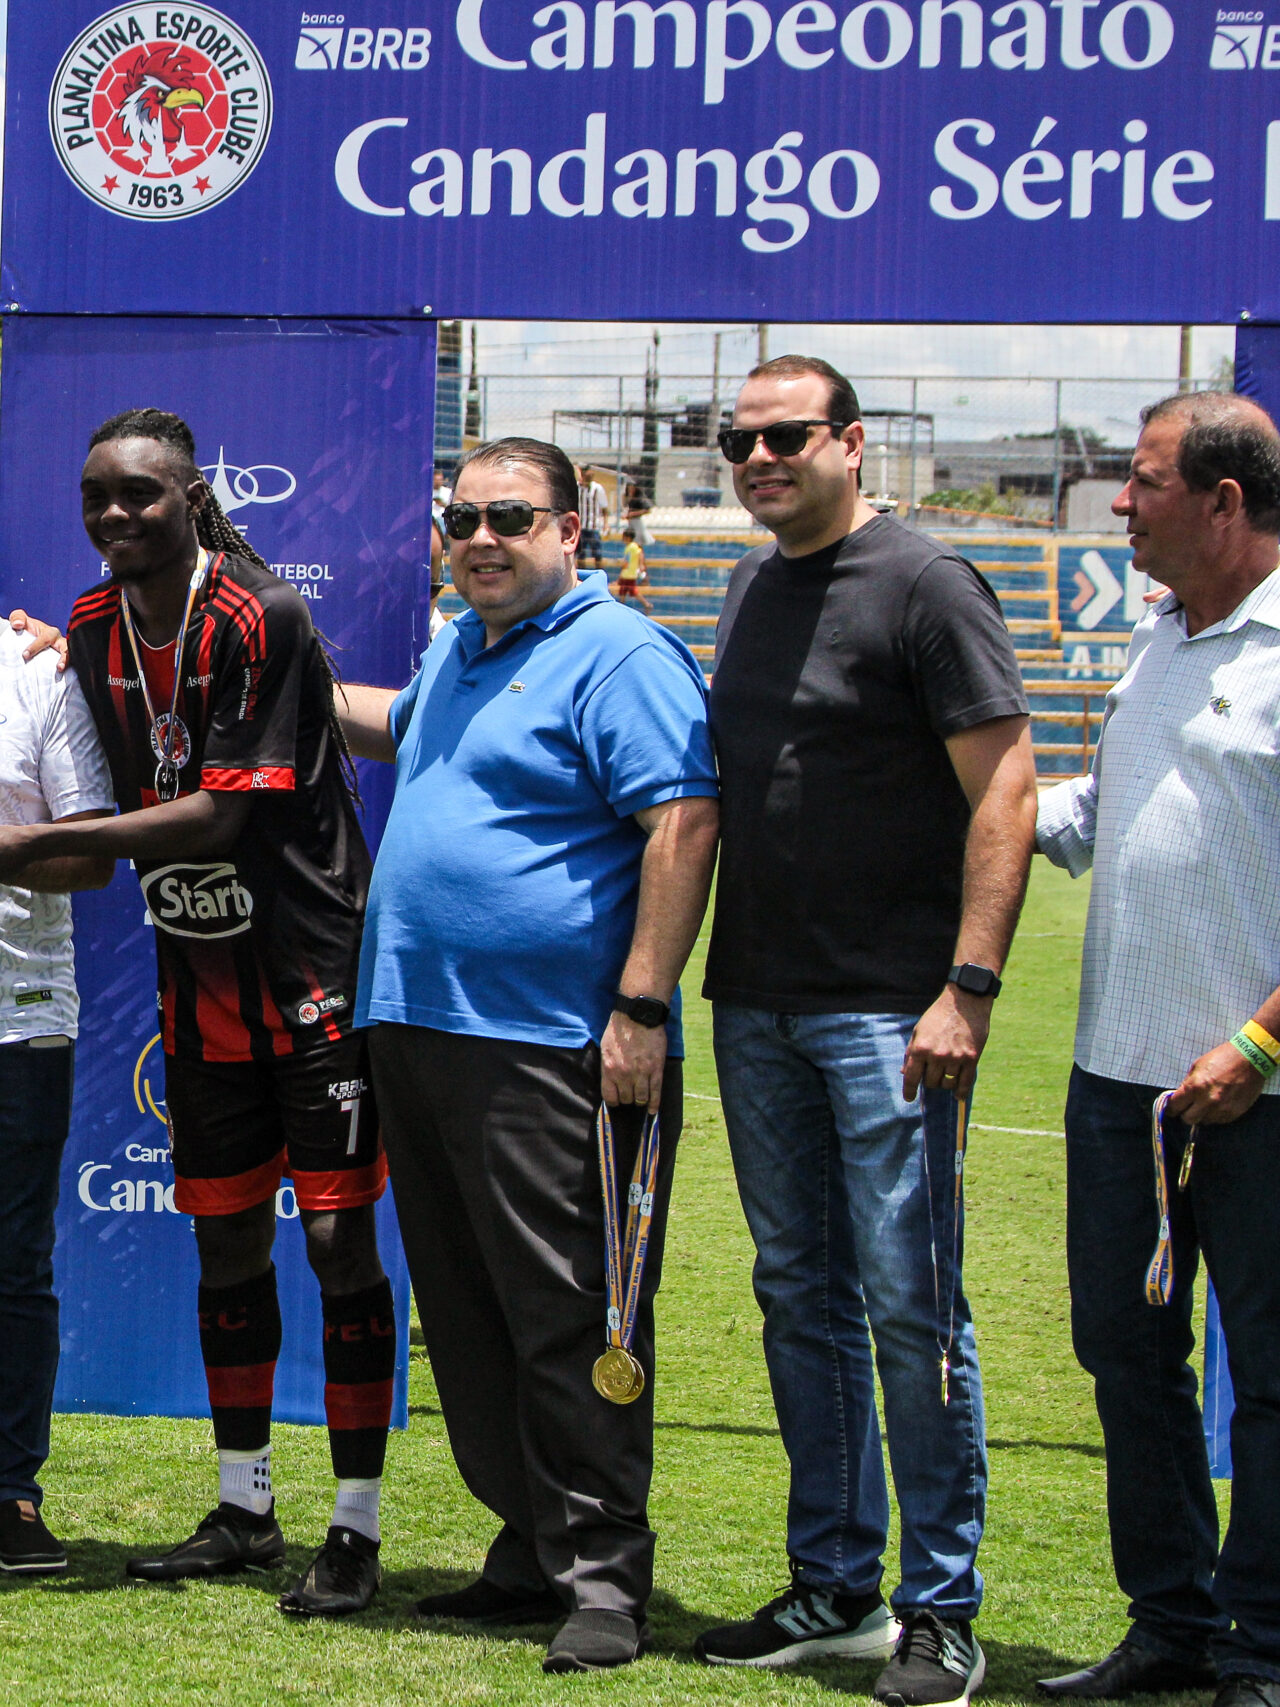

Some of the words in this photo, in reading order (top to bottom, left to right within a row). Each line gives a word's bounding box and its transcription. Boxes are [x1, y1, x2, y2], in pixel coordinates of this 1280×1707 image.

[300, 12, 345, 25] banco
[1215, 9, 1265, 22] banco
[343, 27, 432, 71] BRB
[456, 0, 1175, 106] Campeonato
[62, 16, 145, 151] PLANALTINA
[156, 11, 251, 81] ESPORTE
[217, 86, 258, 166] CLUBE
[127, 182, 184, 209] 1963
[335, 112, 881, 253] Candango
[929, 116, 1215, 221] Série
[159, 877, 248, 920] Start
[327, 1078, 368, 1097] KRAL
[340, 1099, 360, 1155] 7
